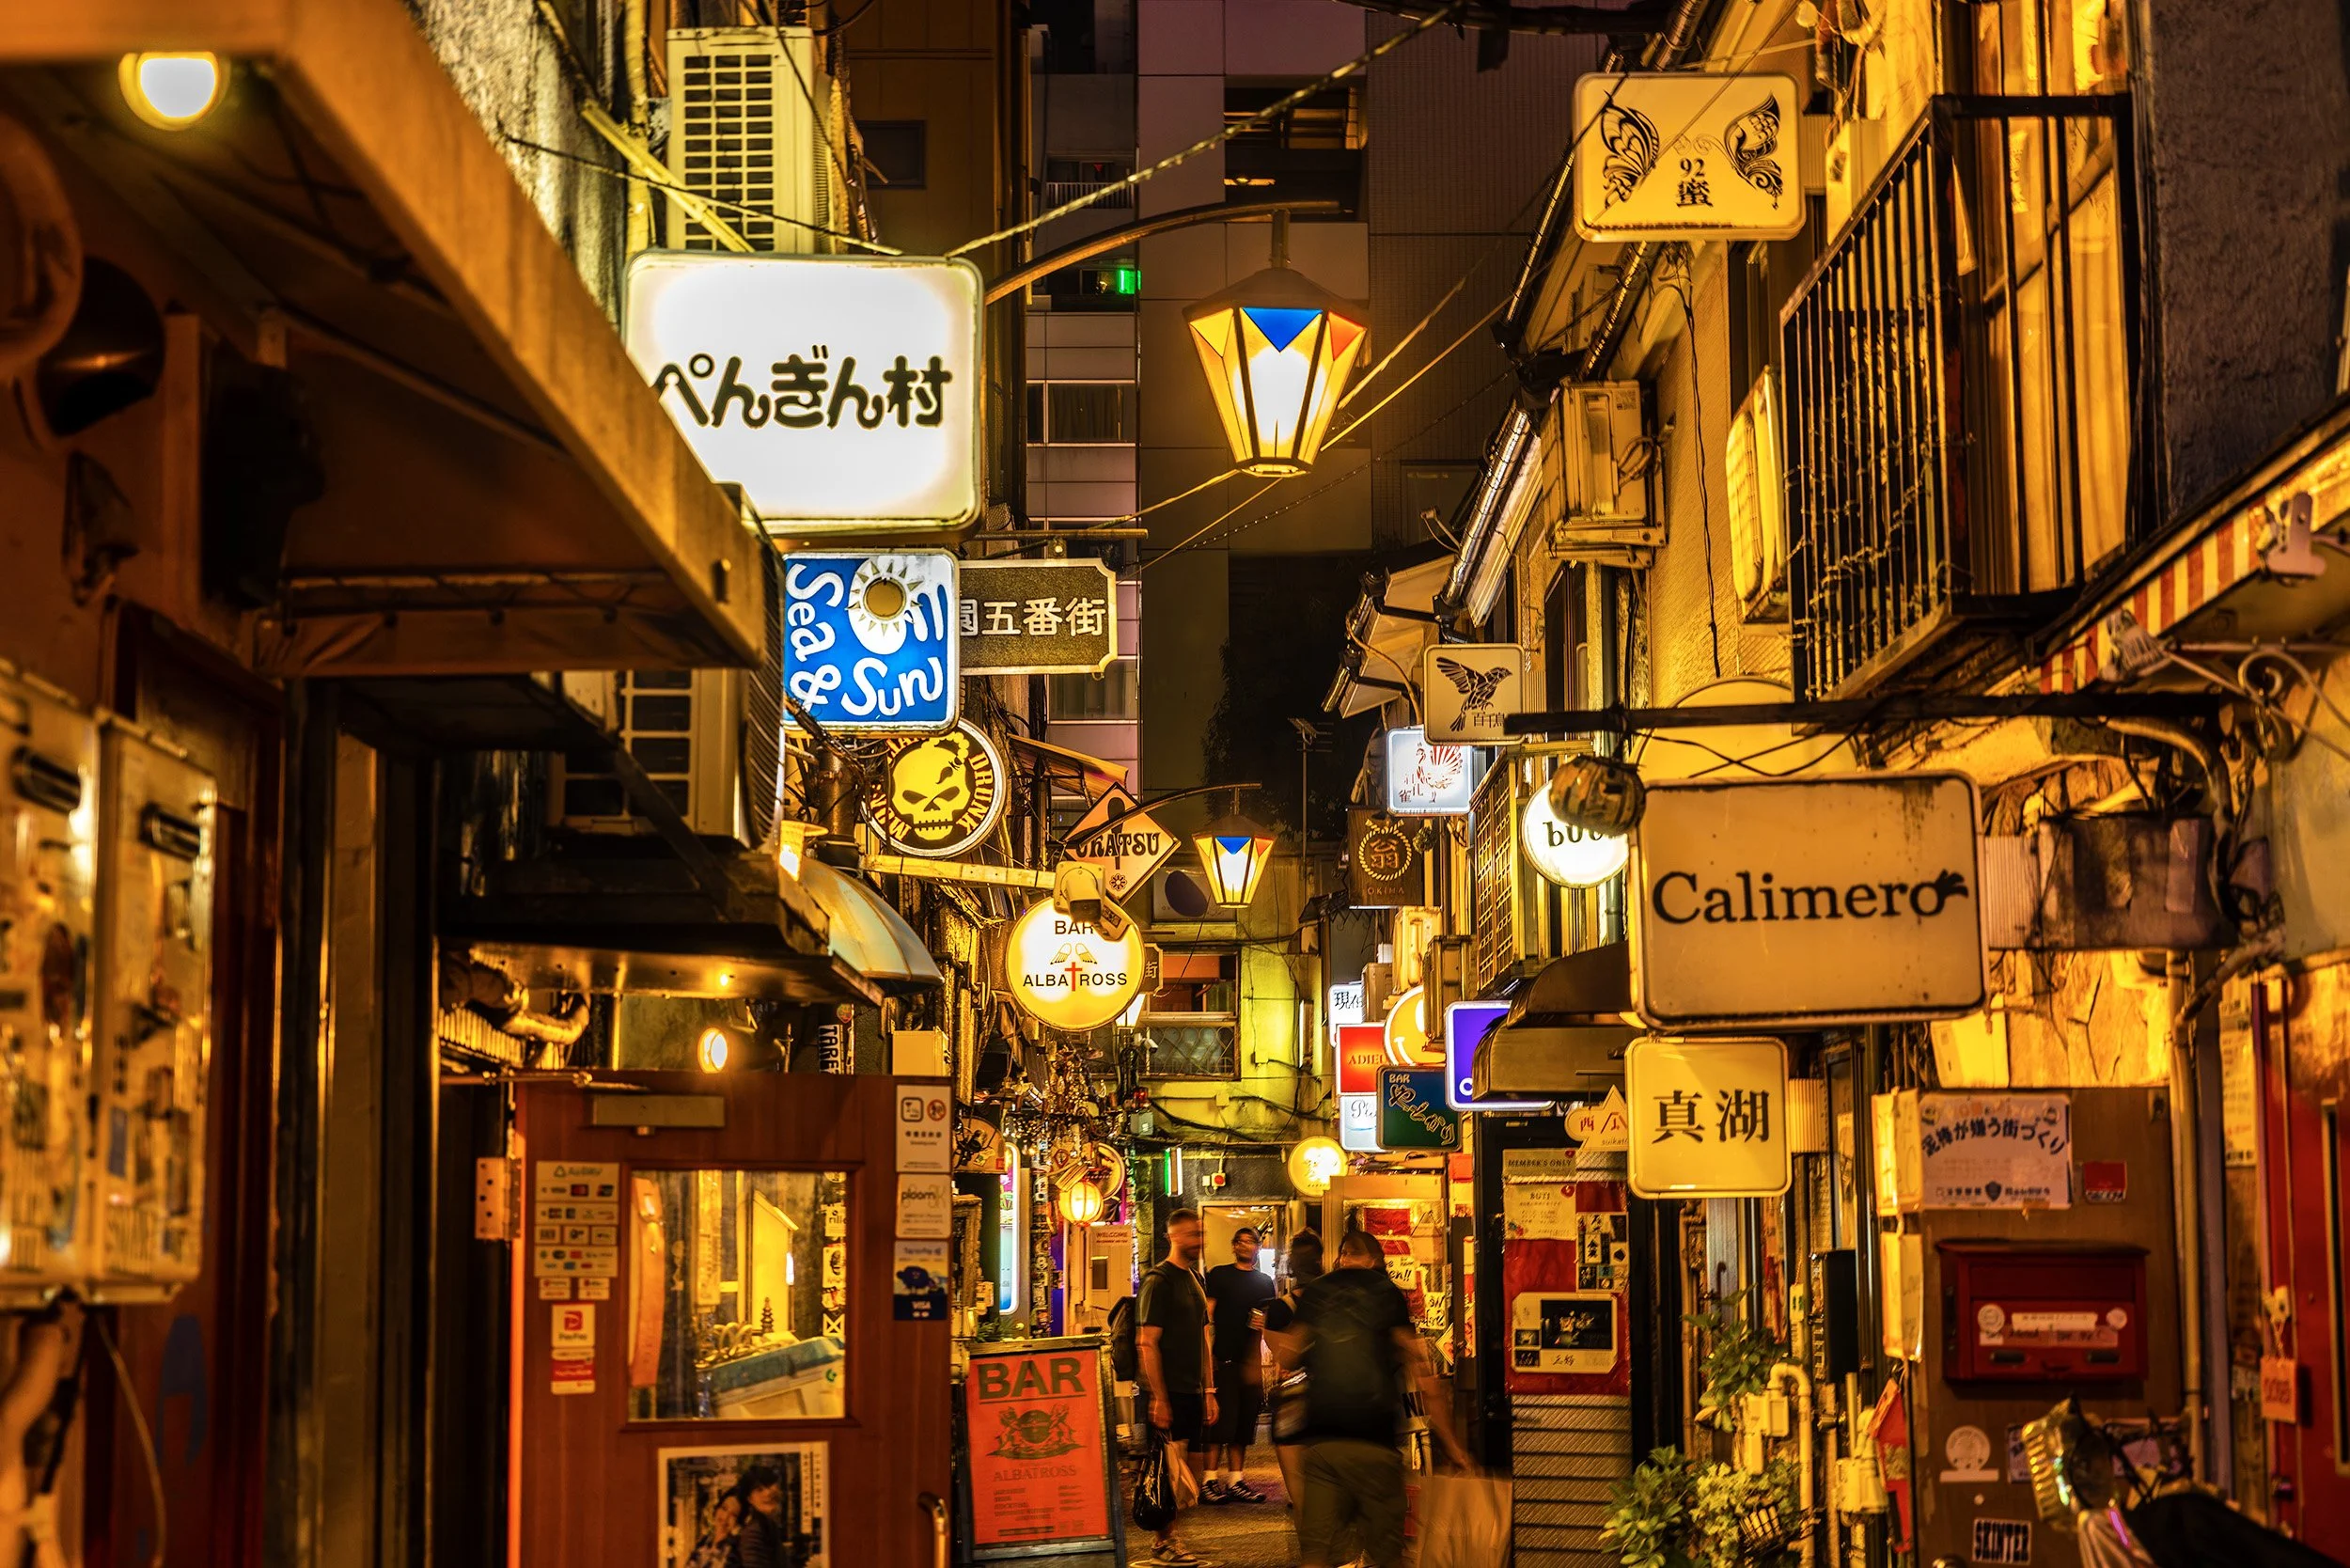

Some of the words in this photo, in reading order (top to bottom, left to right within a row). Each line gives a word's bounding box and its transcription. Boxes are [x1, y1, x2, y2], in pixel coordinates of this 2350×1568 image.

[1680, 158, 1705, 178] 92
[656, 344, 953, 431] ぺんぎん村
[785, 563, 844, 662] Sea
[840, 657, 944, 716] Sun
[955, 752, 995, 836] DRUNK
[1652, 869, 1968, 925] Calimero
[1055, 920, 1094, 936] BAR
[1023, 962, 1128, 992] ALBATROSS
[1388, 1074, 1411, 1084] BAR
[1652, 1089, 1770, 1144] 真湖
[977, 1356, 1086, 1400] BAR
[993, 1465, 1077, 1483] ALBATROSS
